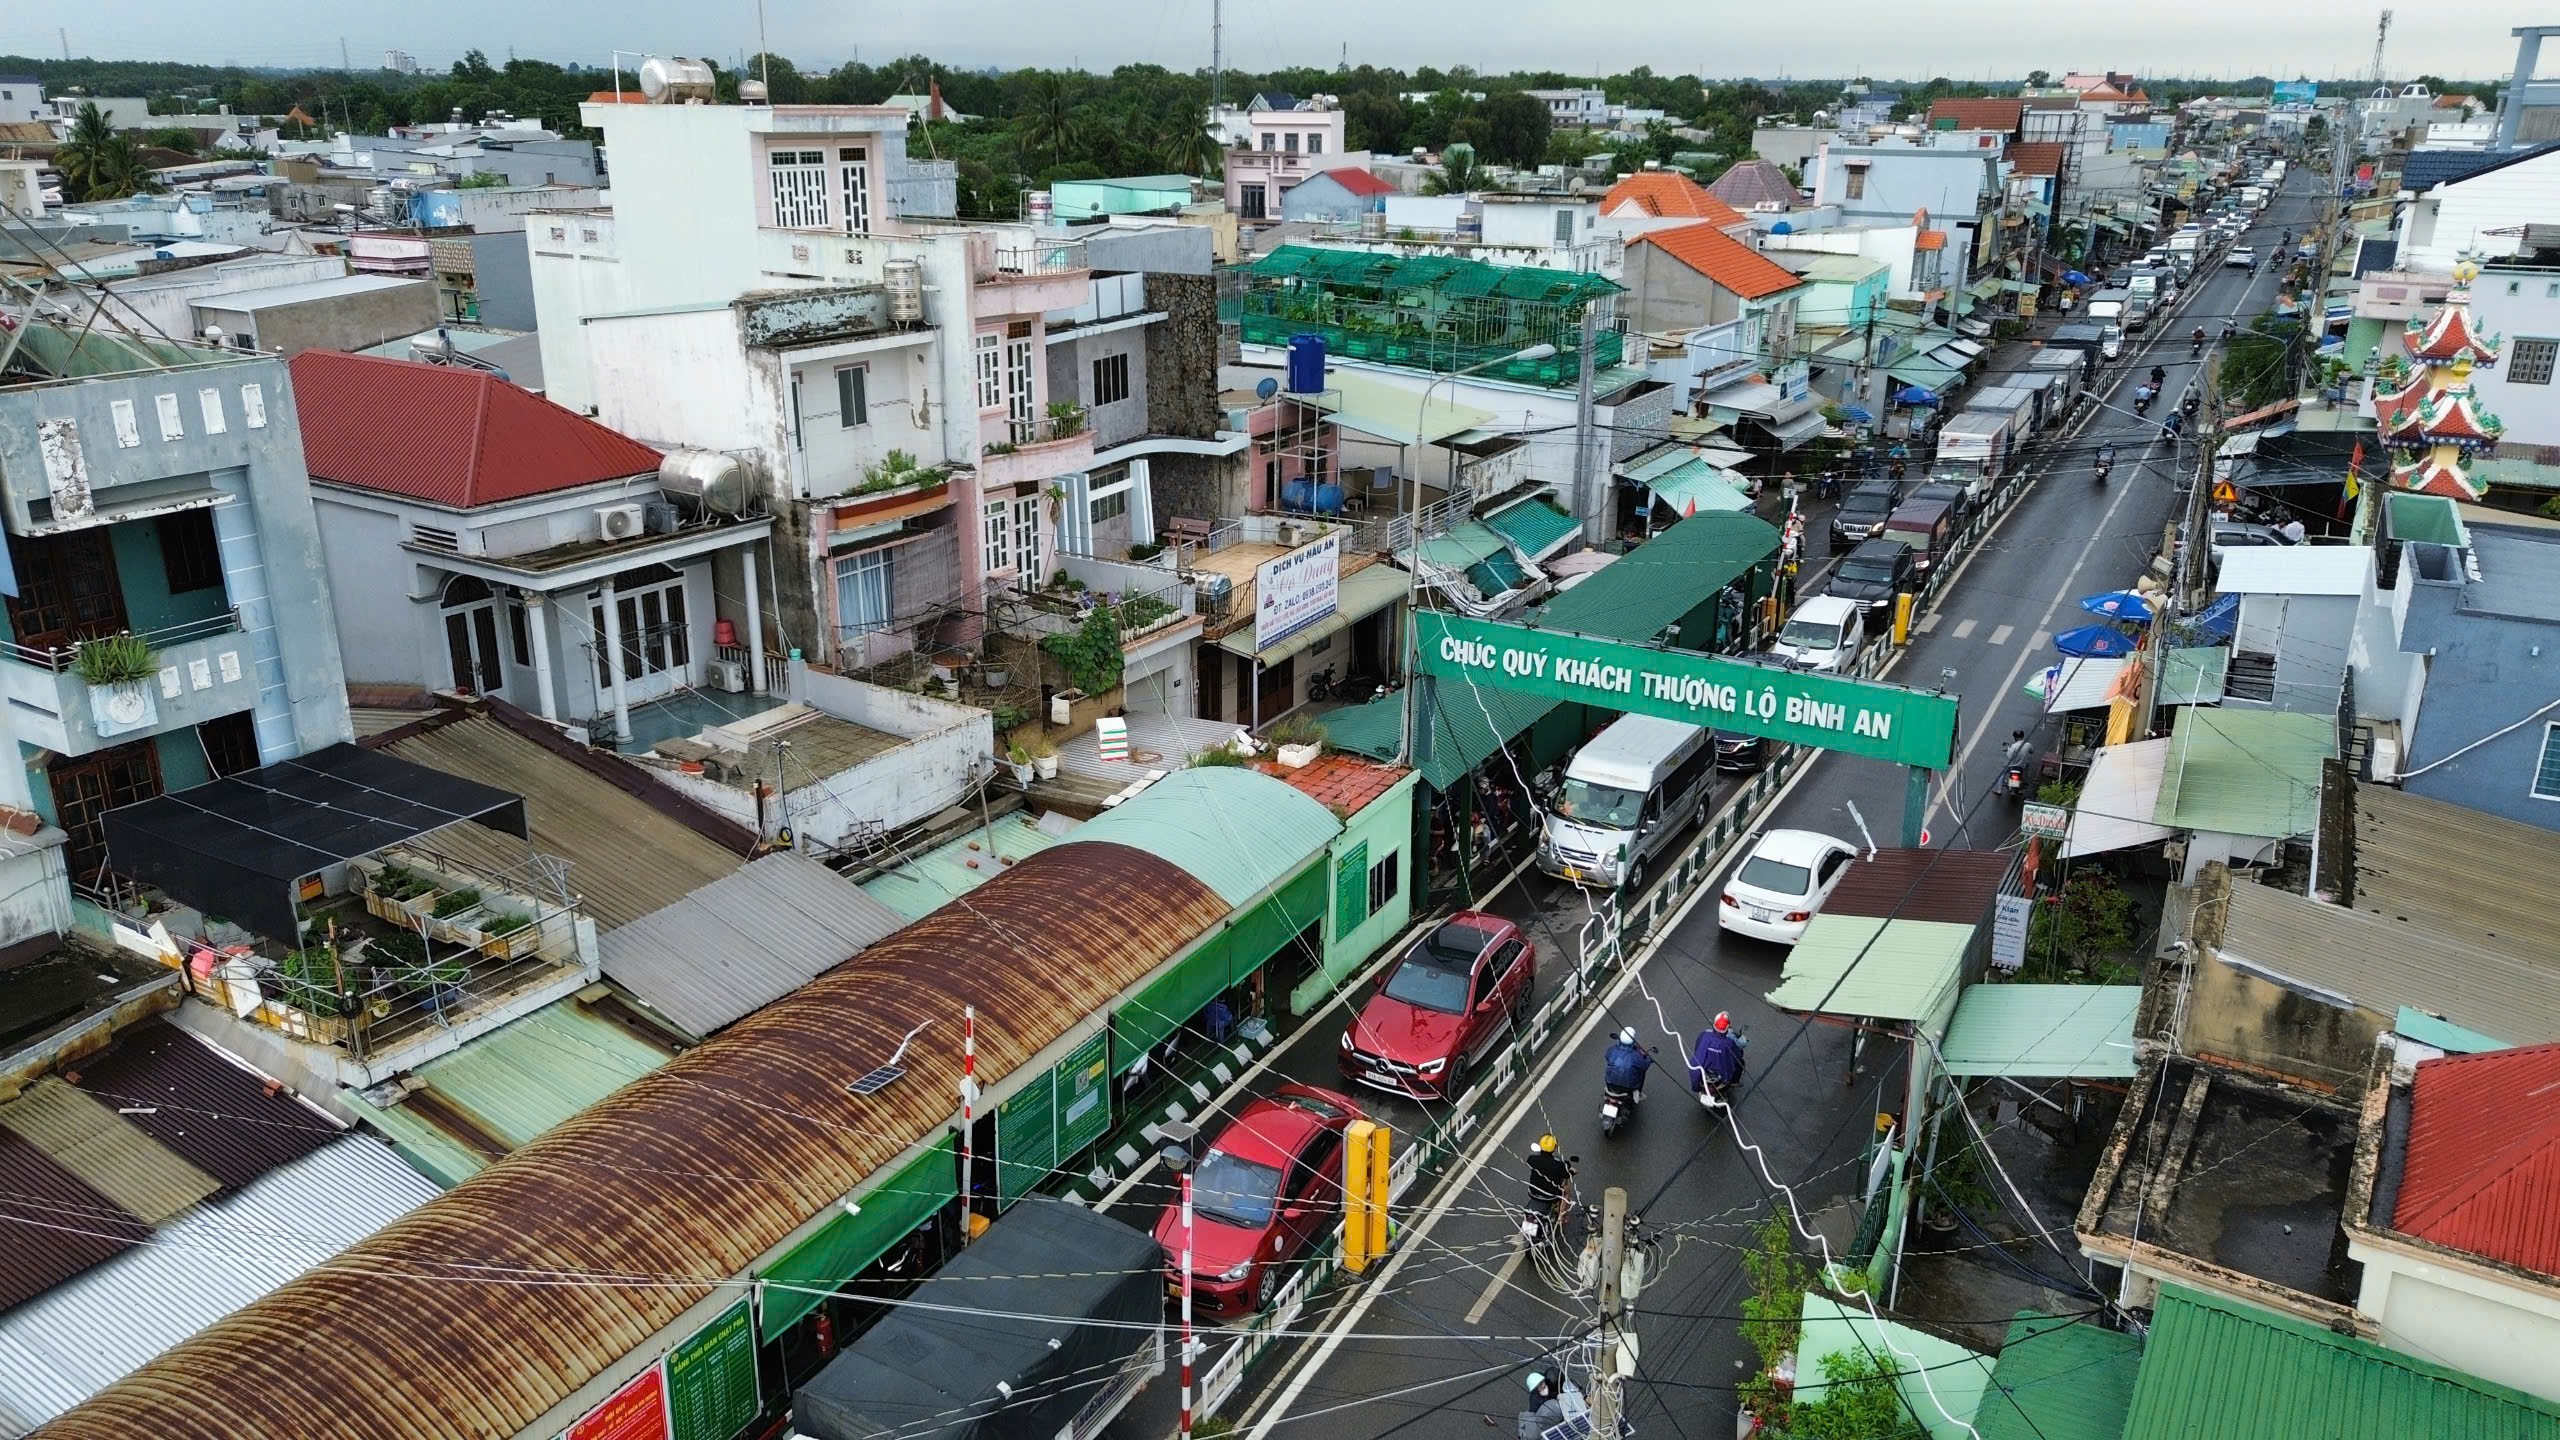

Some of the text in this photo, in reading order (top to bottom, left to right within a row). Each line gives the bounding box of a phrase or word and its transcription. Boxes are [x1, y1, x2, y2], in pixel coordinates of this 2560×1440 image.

[1273, 558, 1292, 576] DỊCH
[1440, 635, 1892, 740] CHÚC QUÝ KHÁCH THƯỢNG LỘ BÌNH AN
[704, 1337, 718, 1352] GIAN
